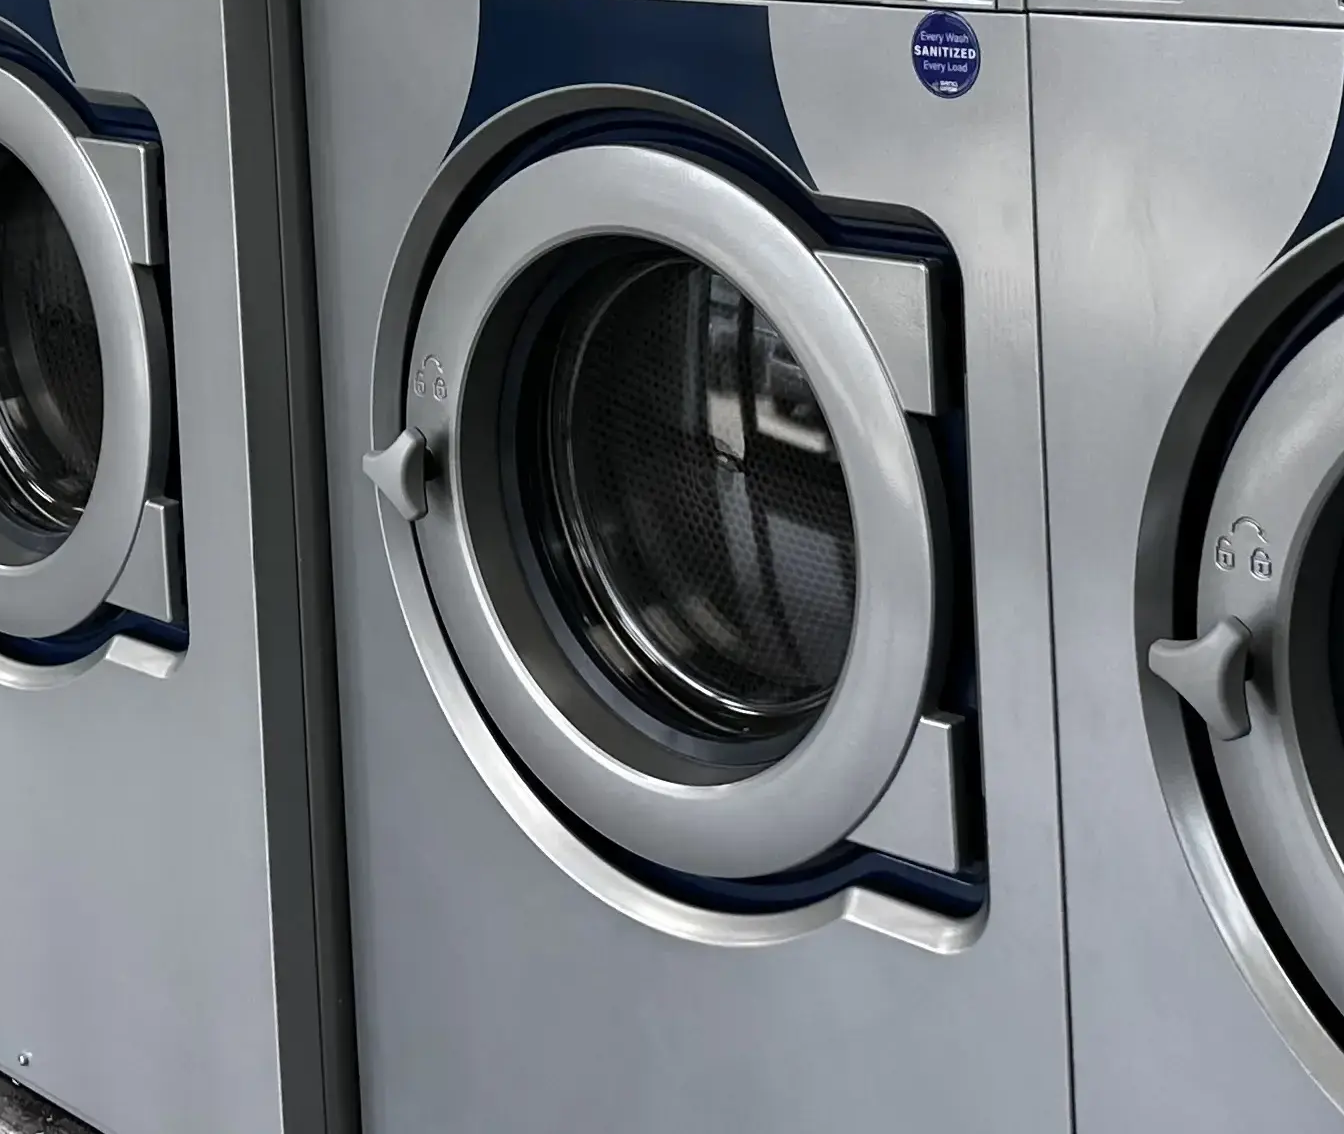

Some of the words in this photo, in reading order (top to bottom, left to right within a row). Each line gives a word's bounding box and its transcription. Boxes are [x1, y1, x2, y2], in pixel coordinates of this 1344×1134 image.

[920, 30, 945, 45] Every
[945, 32, 969, 44] Wash
[914, 44, 976, 60] SANITIZED
[923, 60, 946, 74] Every
[947, 62, 968, 73] Load
